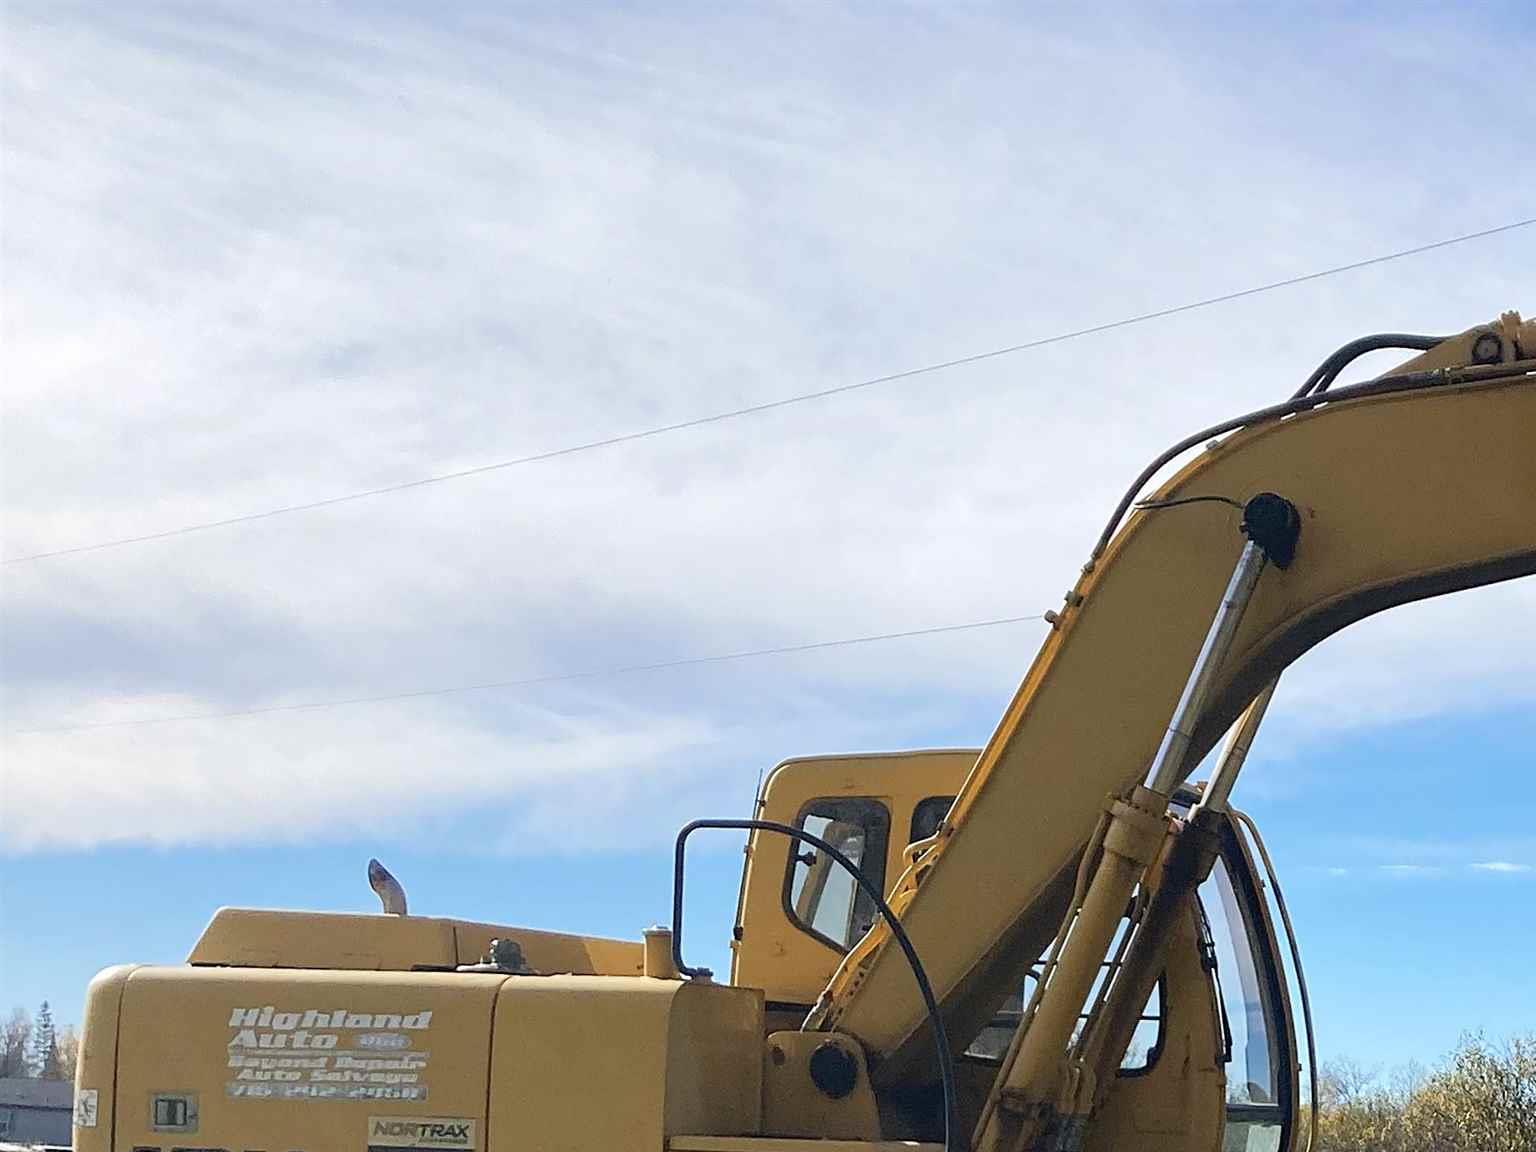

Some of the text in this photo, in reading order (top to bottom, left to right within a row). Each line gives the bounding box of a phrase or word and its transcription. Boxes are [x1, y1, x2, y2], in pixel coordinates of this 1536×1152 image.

[228, 1006, 433, 1030] Highland
[228, 1029, 339, 1049] Auto
[374, 1121, 469, 1138] NORTRAX
